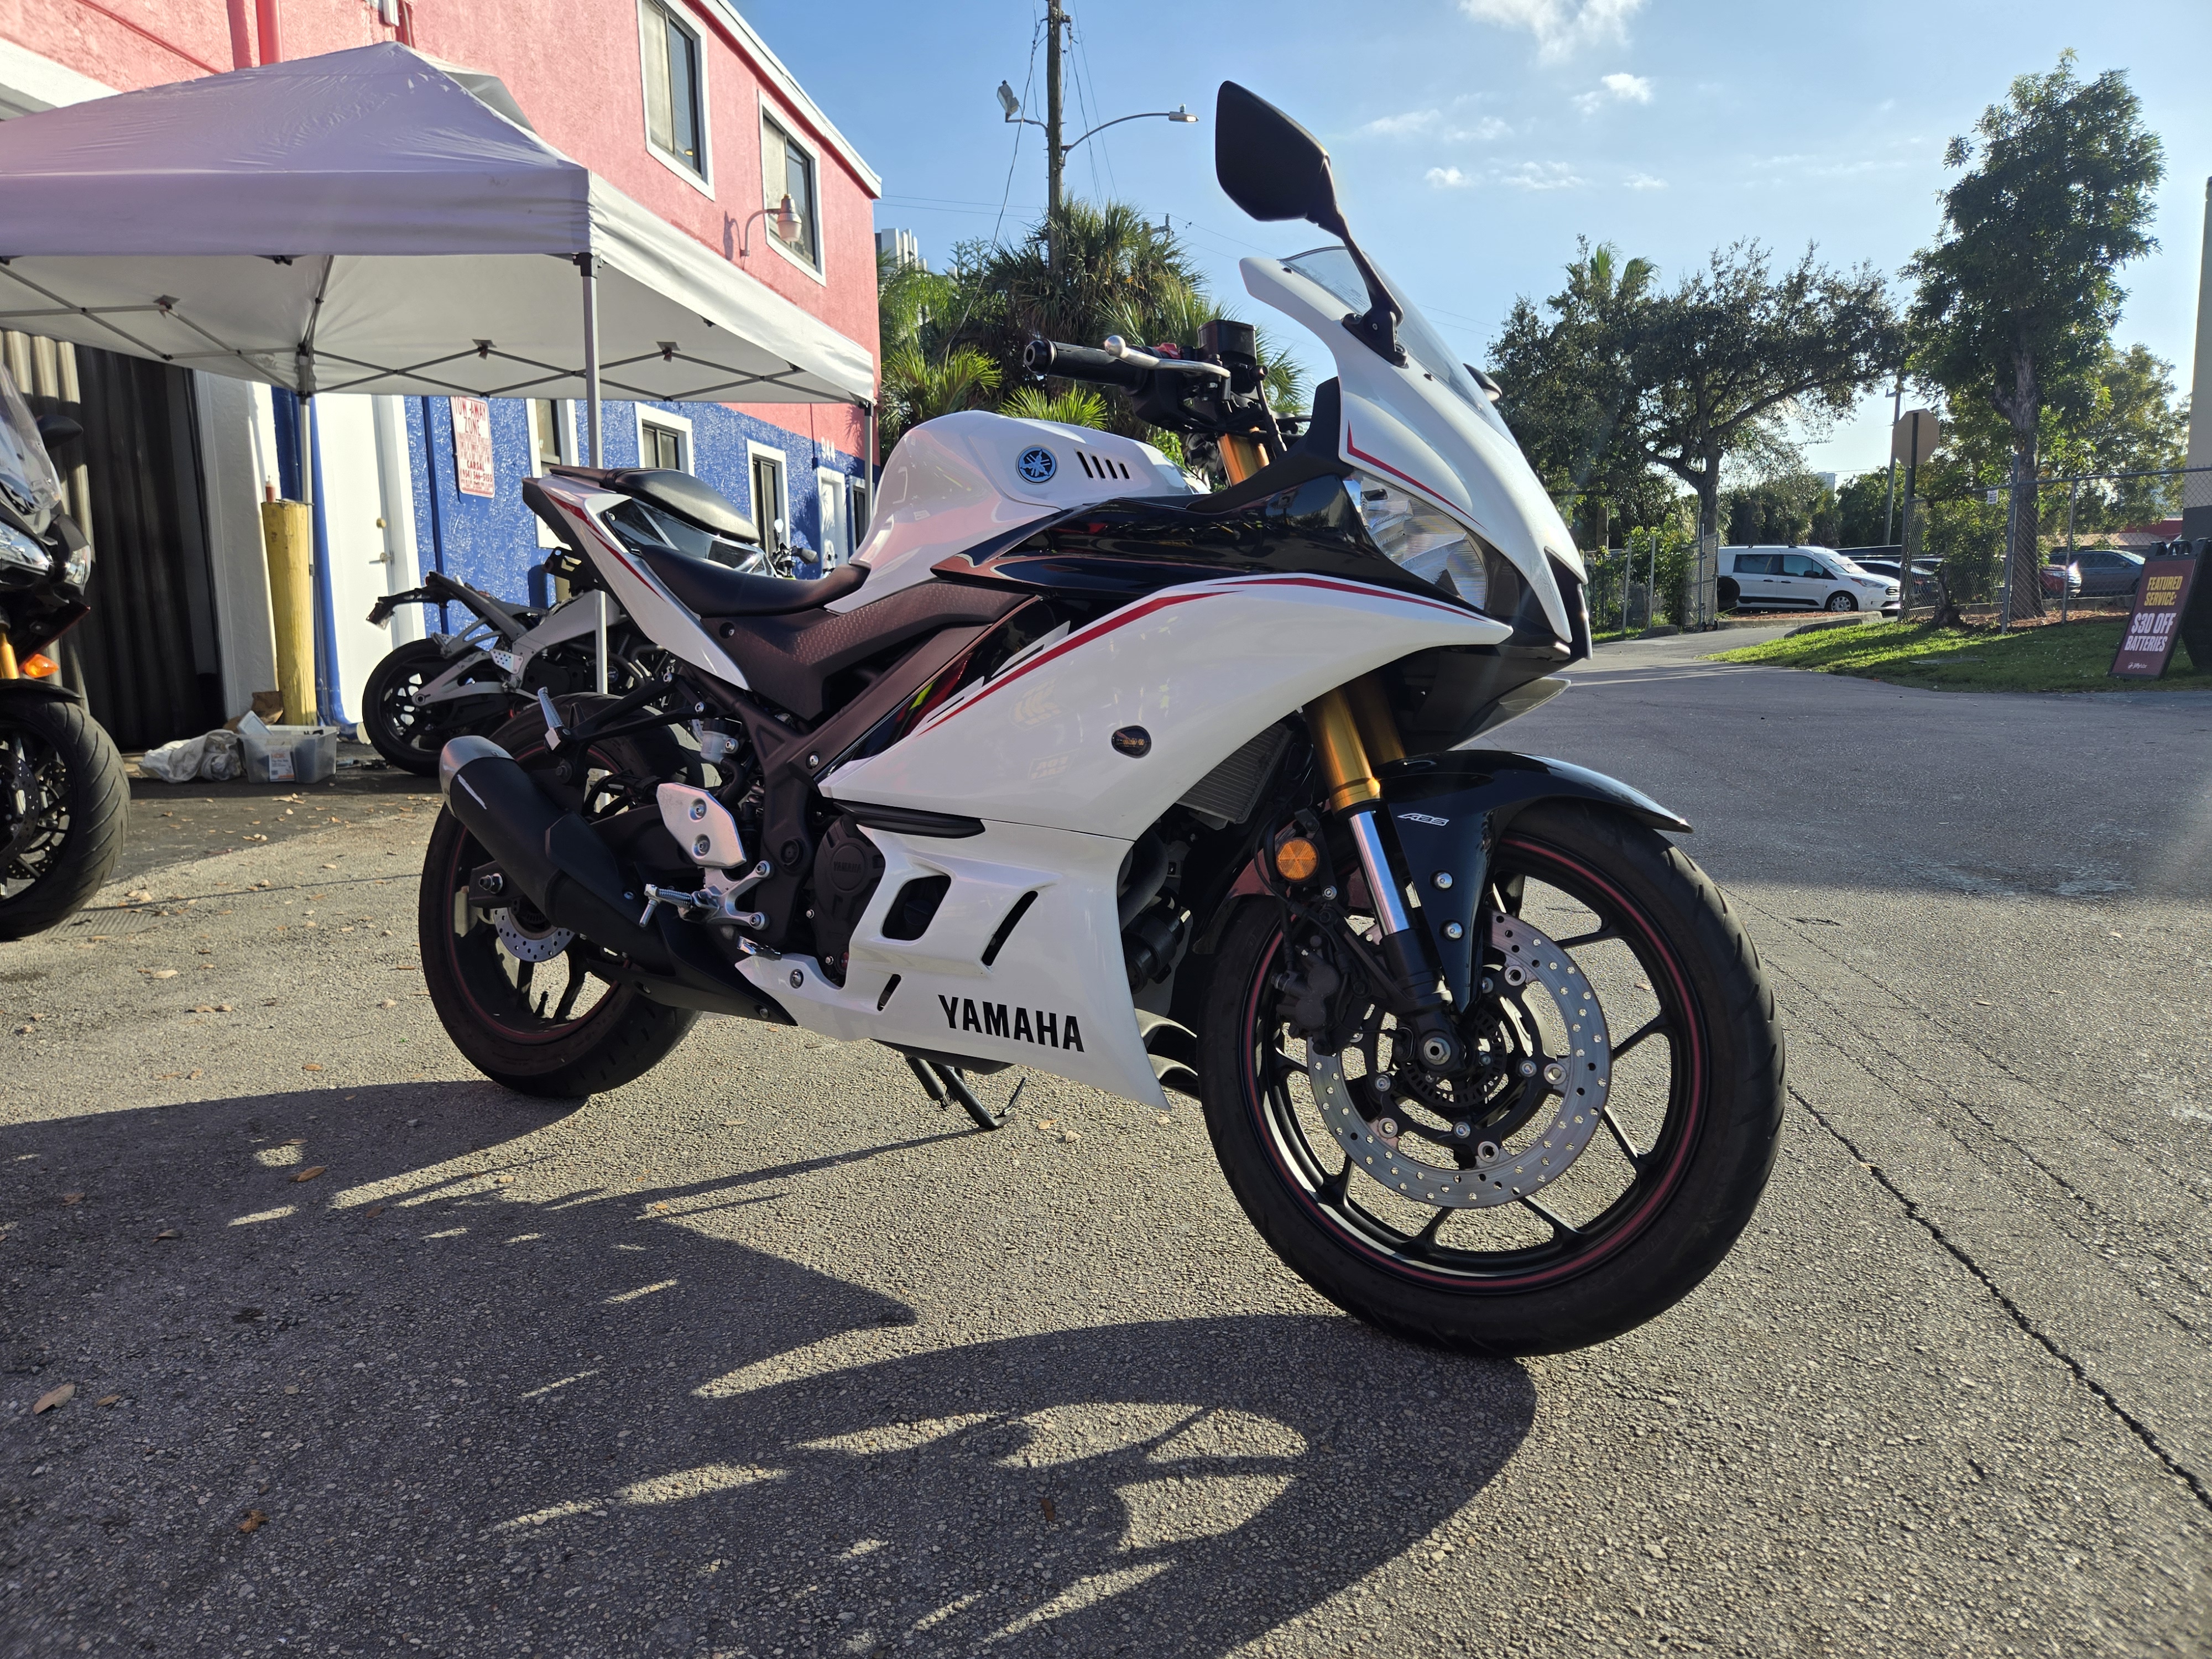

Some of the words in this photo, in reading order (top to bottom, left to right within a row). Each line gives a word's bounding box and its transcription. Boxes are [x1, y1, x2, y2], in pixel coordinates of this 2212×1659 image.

[463, 416, 481, 436] ZONE
[821, 436, 836, 463] 944
[467, 460, 484, 472] CARSAL
[2147, 576, 2183, 591] FEATURED
[2144, 592, 2177, 606] SERVICE:
[2131, 612, 2156, 634] $30
[2153, 613, 2177, 634] OFF
[2124, 635, 2168, 651] BATTERIES
[1397, 813, 1449, 826] ABS
[938, 994, 1085, 1052] YAMAHA
